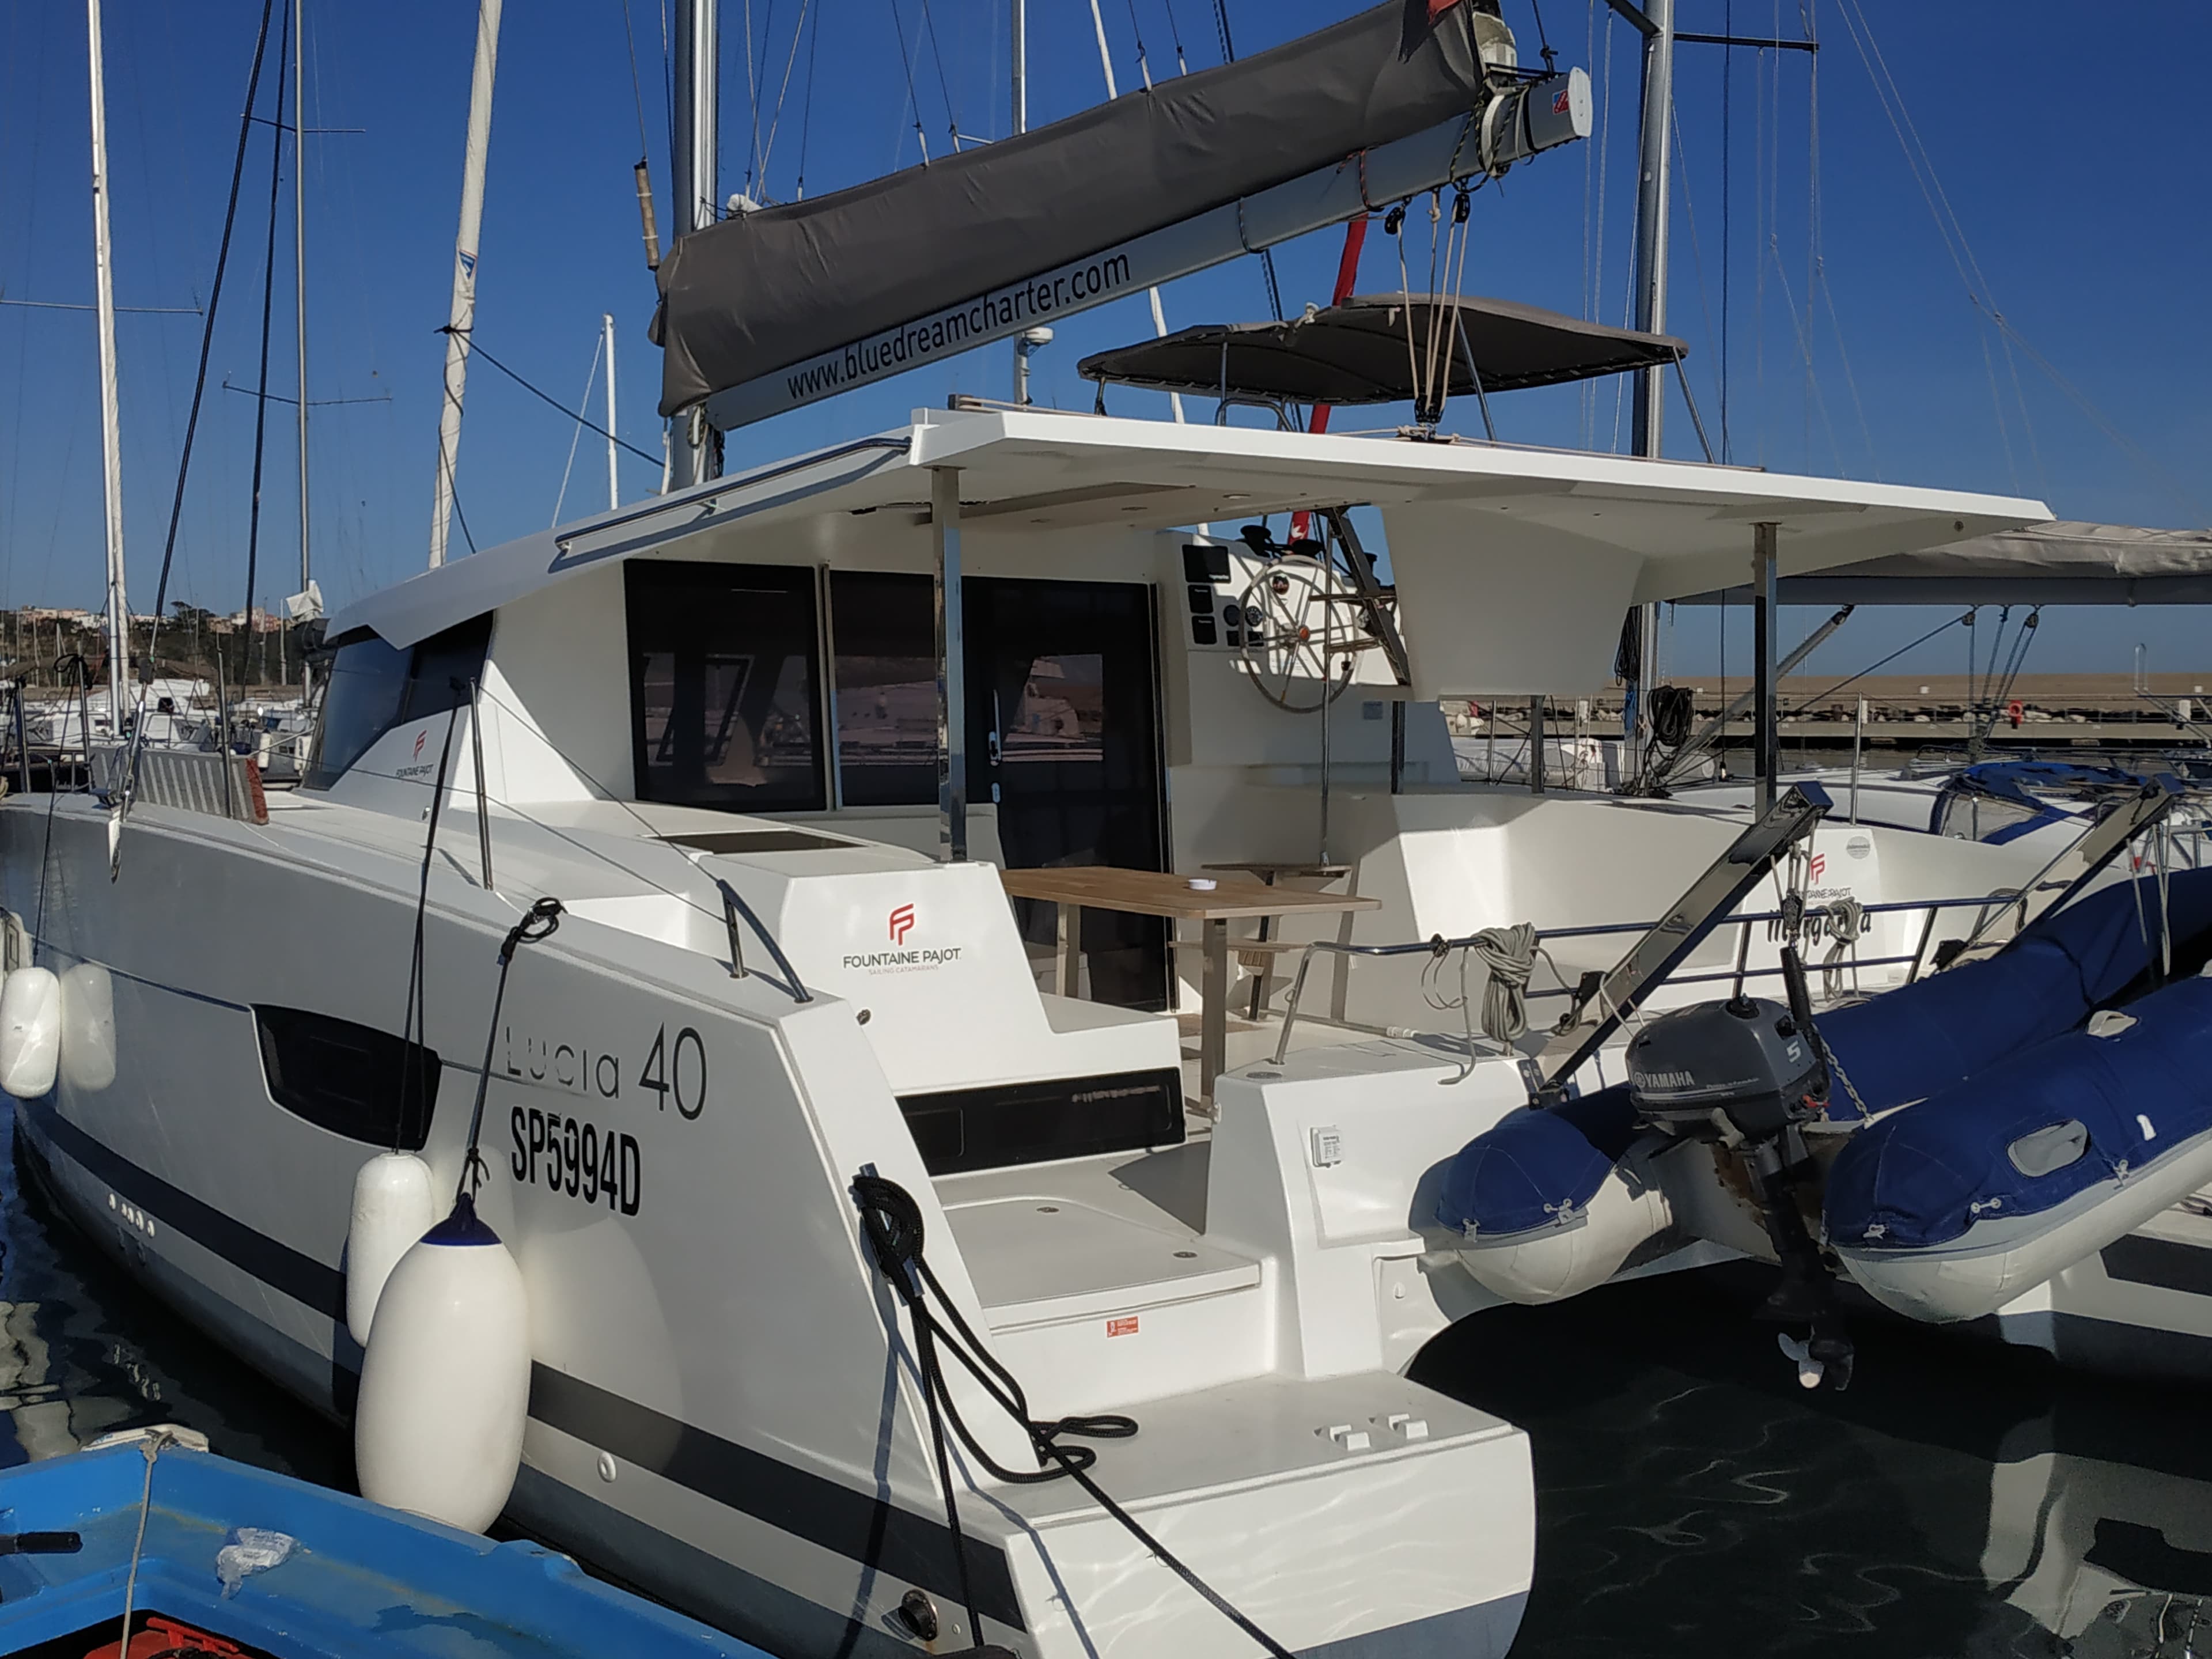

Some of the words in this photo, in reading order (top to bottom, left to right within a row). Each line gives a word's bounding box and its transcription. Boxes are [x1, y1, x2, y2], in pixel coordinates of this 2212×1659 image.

[787, 253, 1131, 399] www.bluedreamcharter.com
[843, 950, 920, 969] FOUNTAINE
[923, 948, 961, 964] PAJOT
[639, 1021, 707, 1120] 40
[1645, 1071, 1695, 1088] YAMAHA
[1786, 1040, 1801, 1063] 5
[511, 1106, 641, 1217] SP5994D
